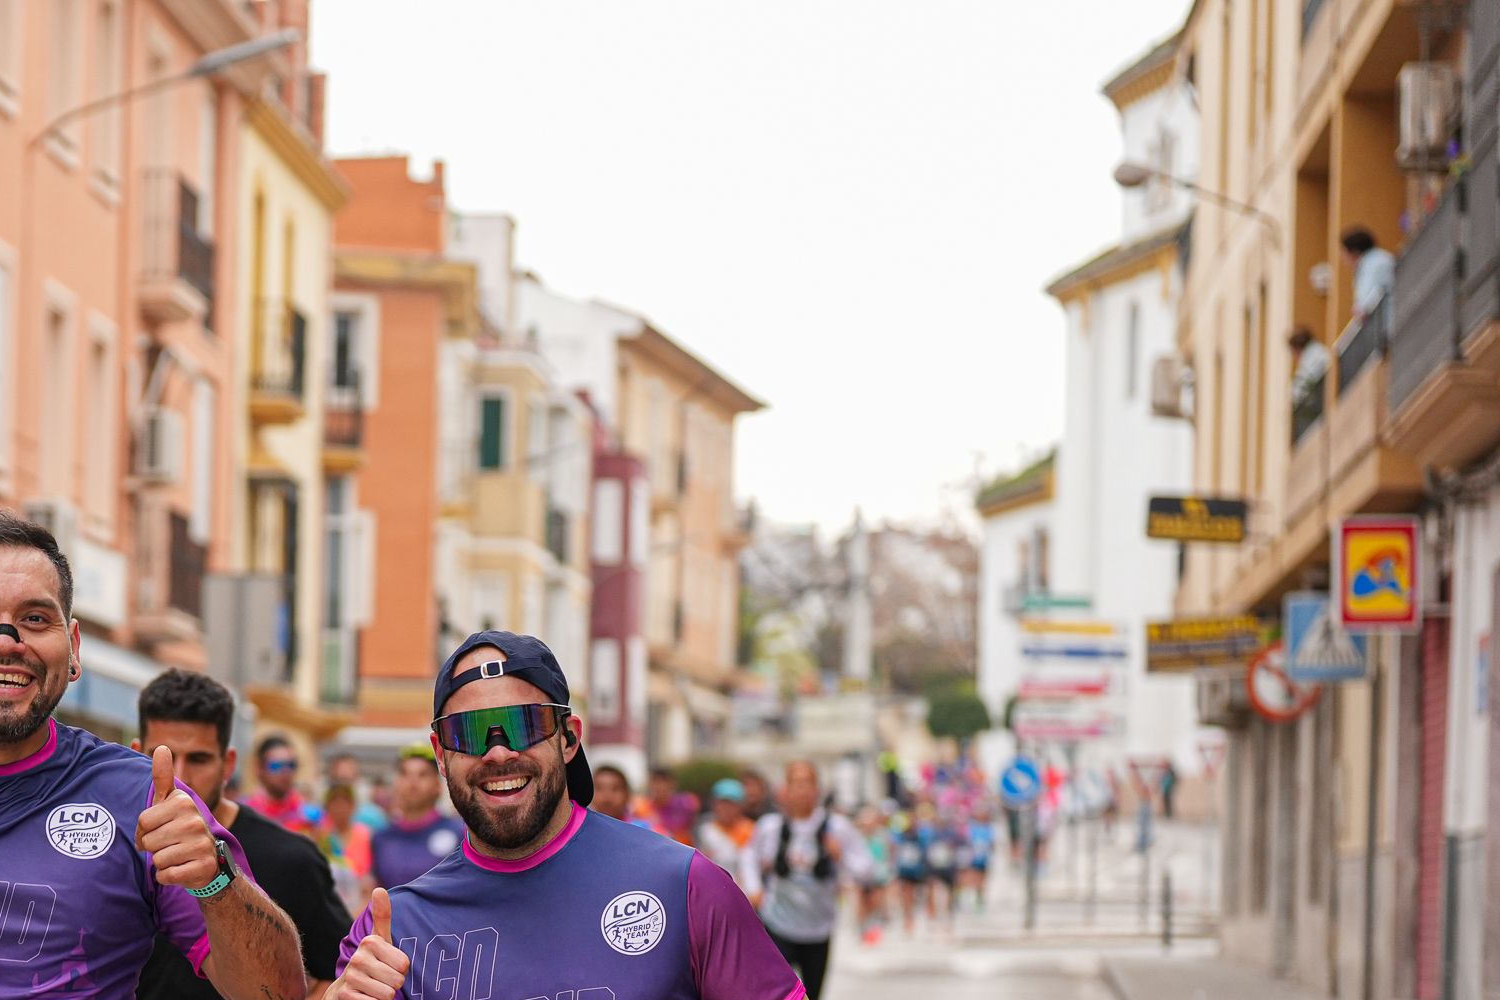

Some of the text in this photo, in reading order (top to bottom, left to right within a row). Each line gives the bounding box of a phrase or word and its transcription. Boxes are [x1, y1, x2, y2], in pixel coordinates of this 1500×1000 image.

[59, 810, 99, 823] LCN
[613, 899, 650, 918] LCN
[623, 923, 651, 934] HYBRID
[626, 930, 649, 939] TEAM
